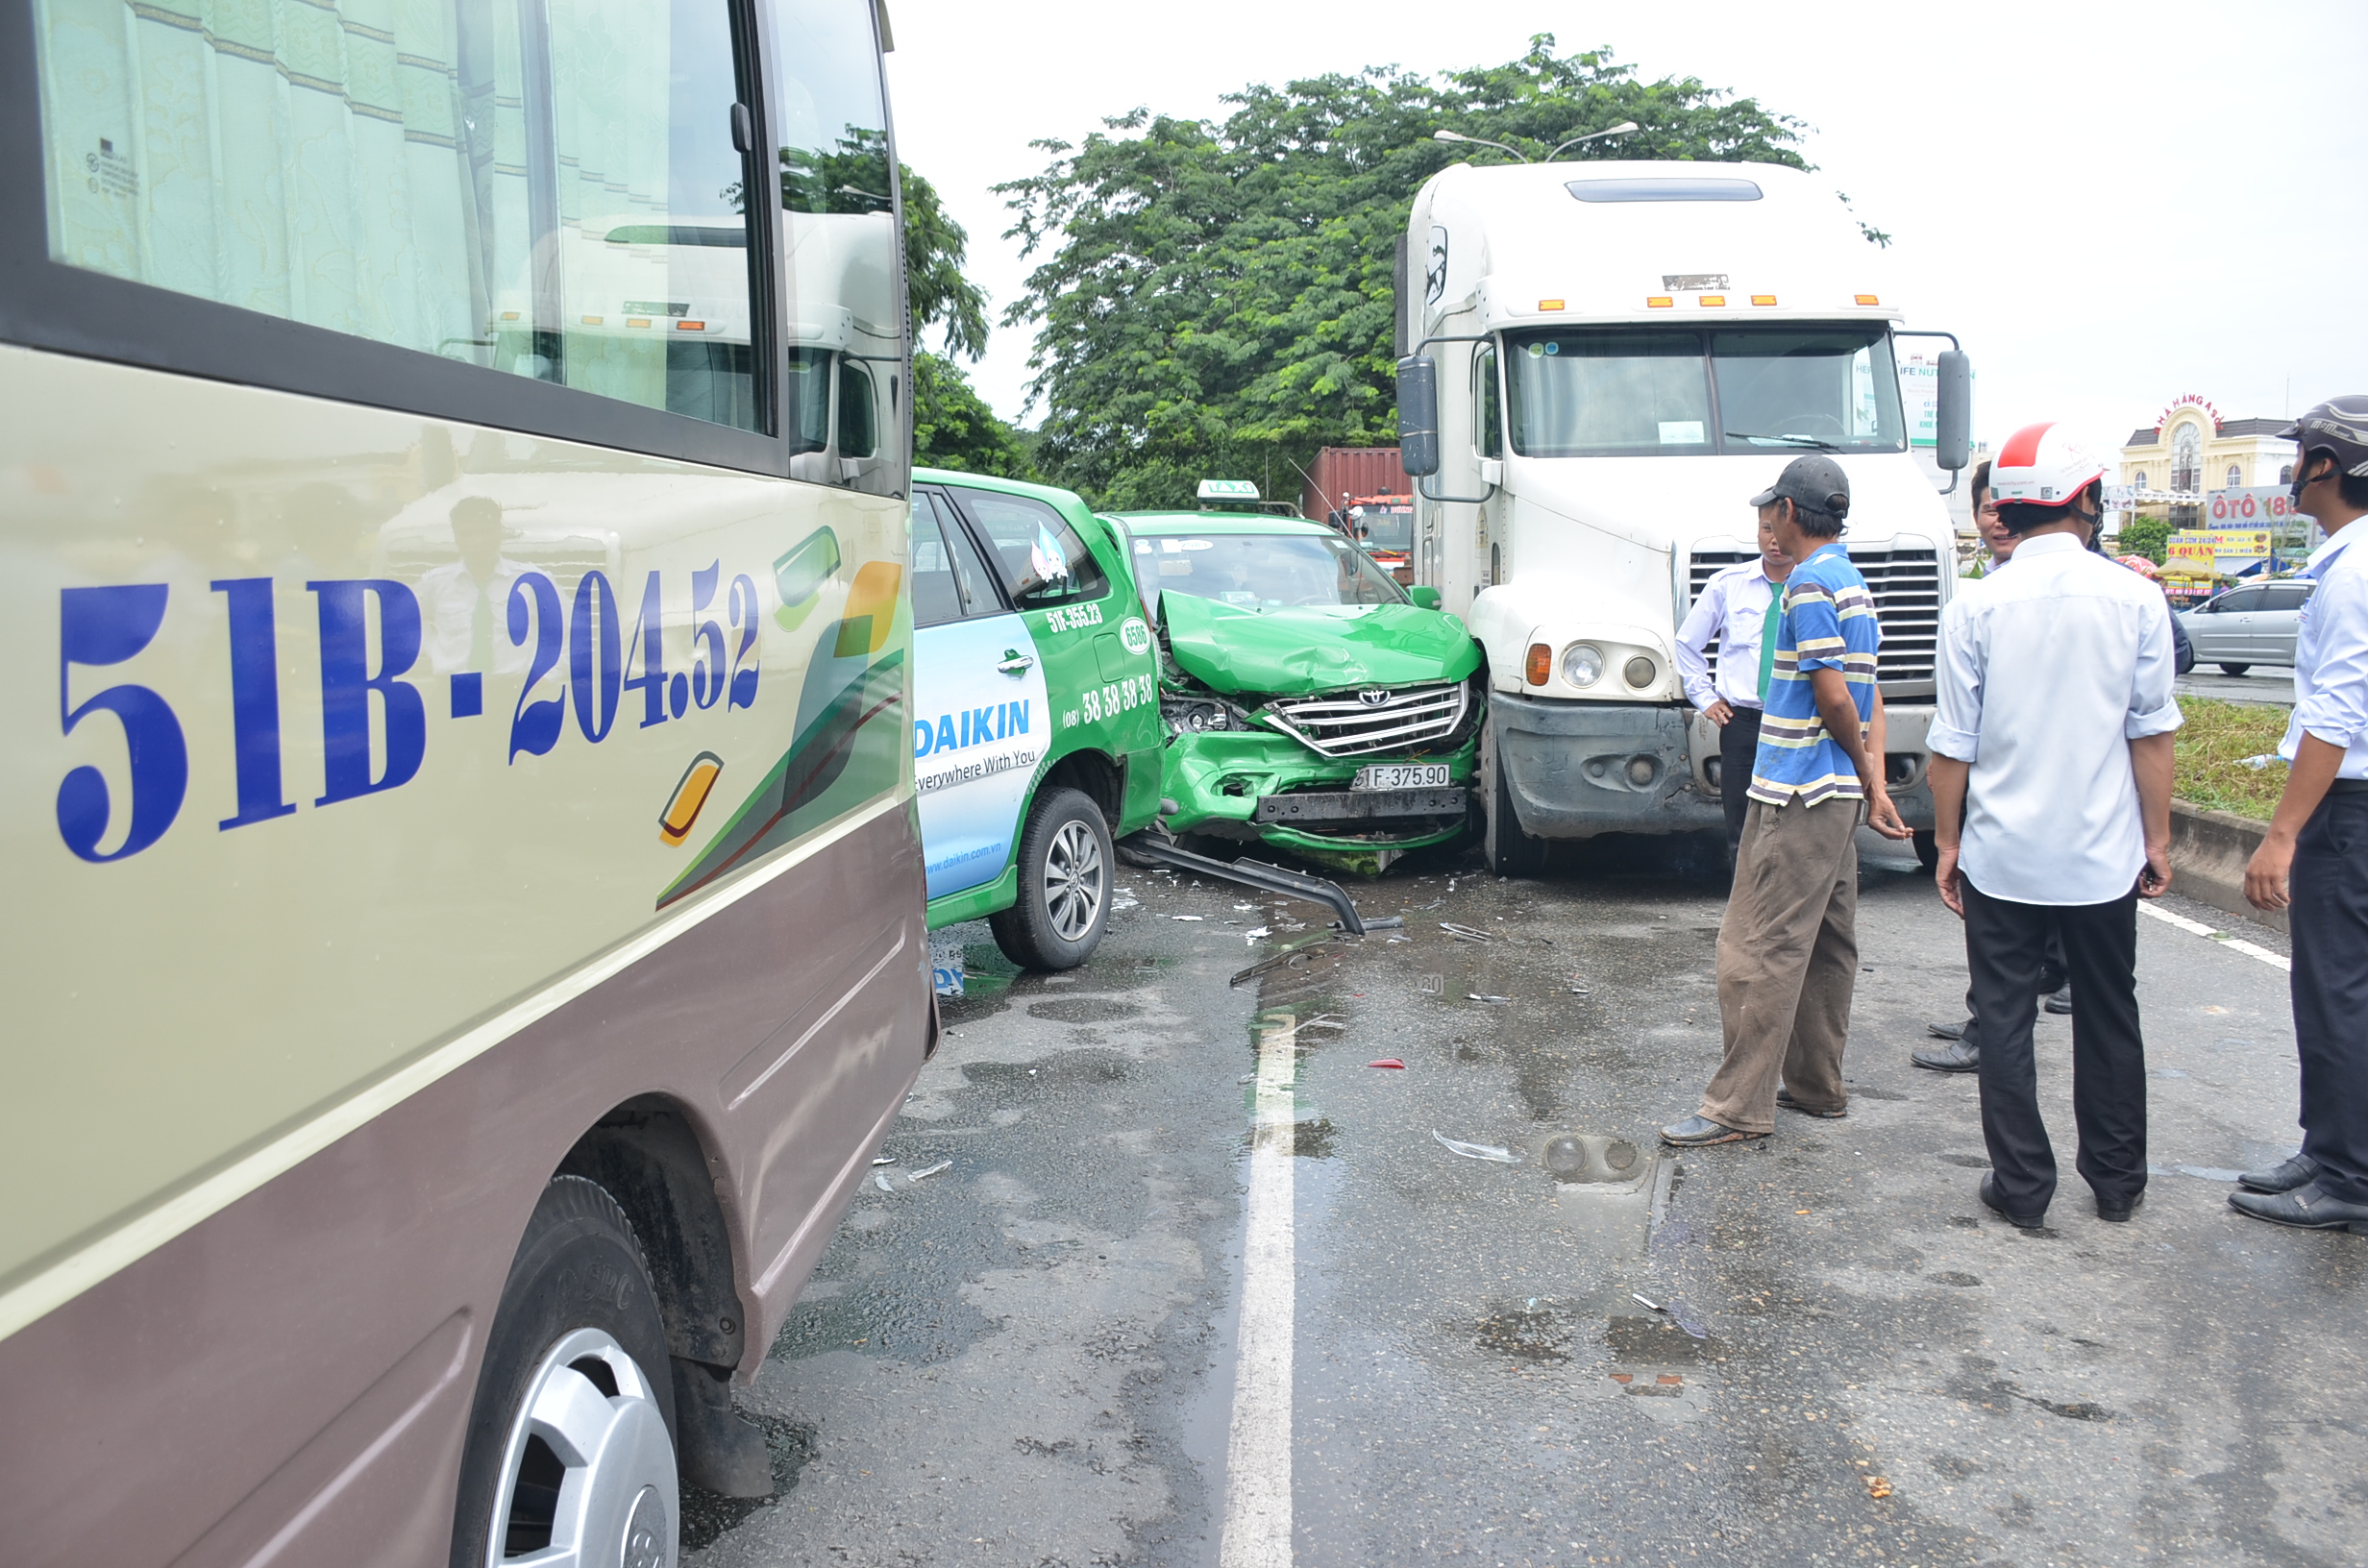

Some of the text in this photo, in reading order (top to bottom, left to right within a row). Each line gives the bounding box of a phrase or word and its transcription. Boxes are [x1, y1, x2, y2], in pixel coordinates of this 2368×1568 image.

[2172, 392, 2204, 409] HÀNG
[2212, 493, 2257, 519] ÔTÔ
[1046, 602, 1103, 633] 51F-355.23
[1124, 625, 1147, 647] 6586
[1062, 673, 1153, 728] (08) 38 38 38 38
[914, 698, 1029, 758] DAIKIN
[983, 752, 1011, 772] With
[1012, 750, 1036, 765] You
[1354, 767, 1446, 786] 51F-375.90
